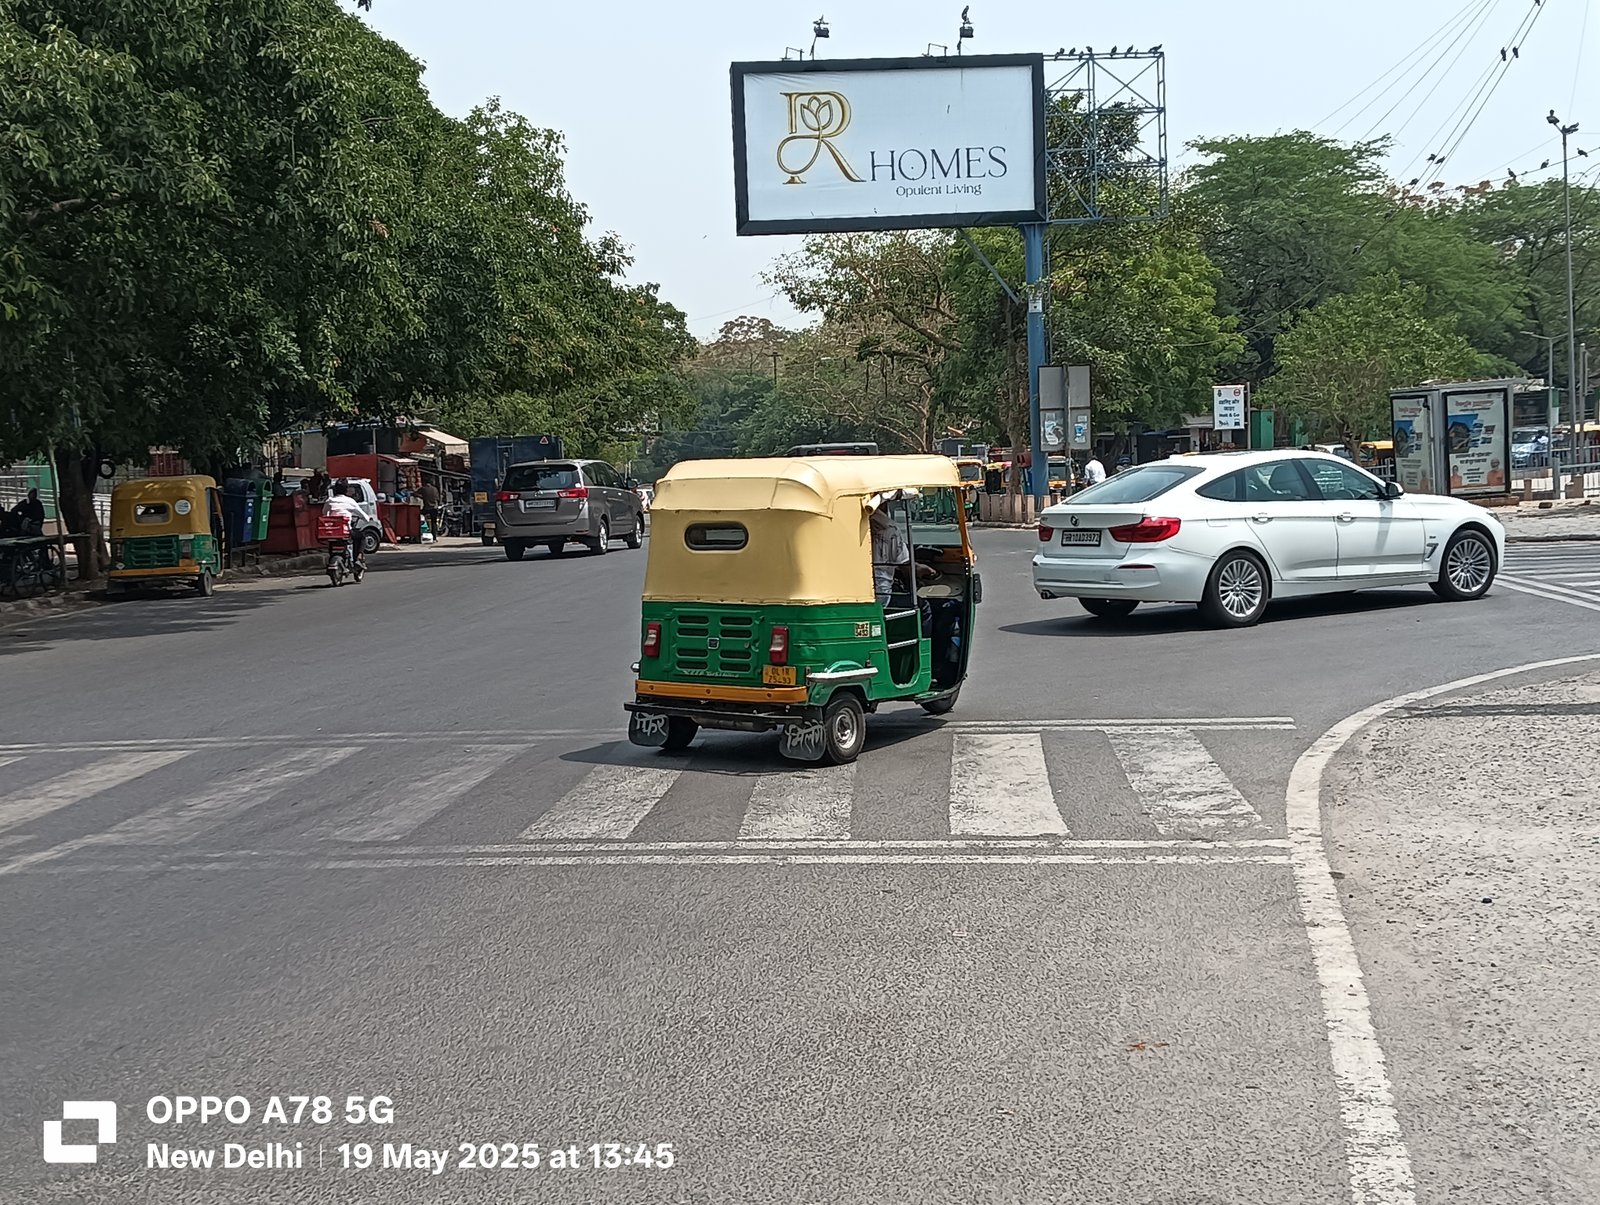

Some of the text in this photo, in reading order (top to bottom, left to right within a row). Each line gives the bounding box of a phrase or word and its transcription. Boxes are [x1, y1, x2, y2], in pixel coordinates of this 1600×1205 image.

[869, 145, 1008, 182] HOMES
[896, 182, 983, 198] Opulent Living
